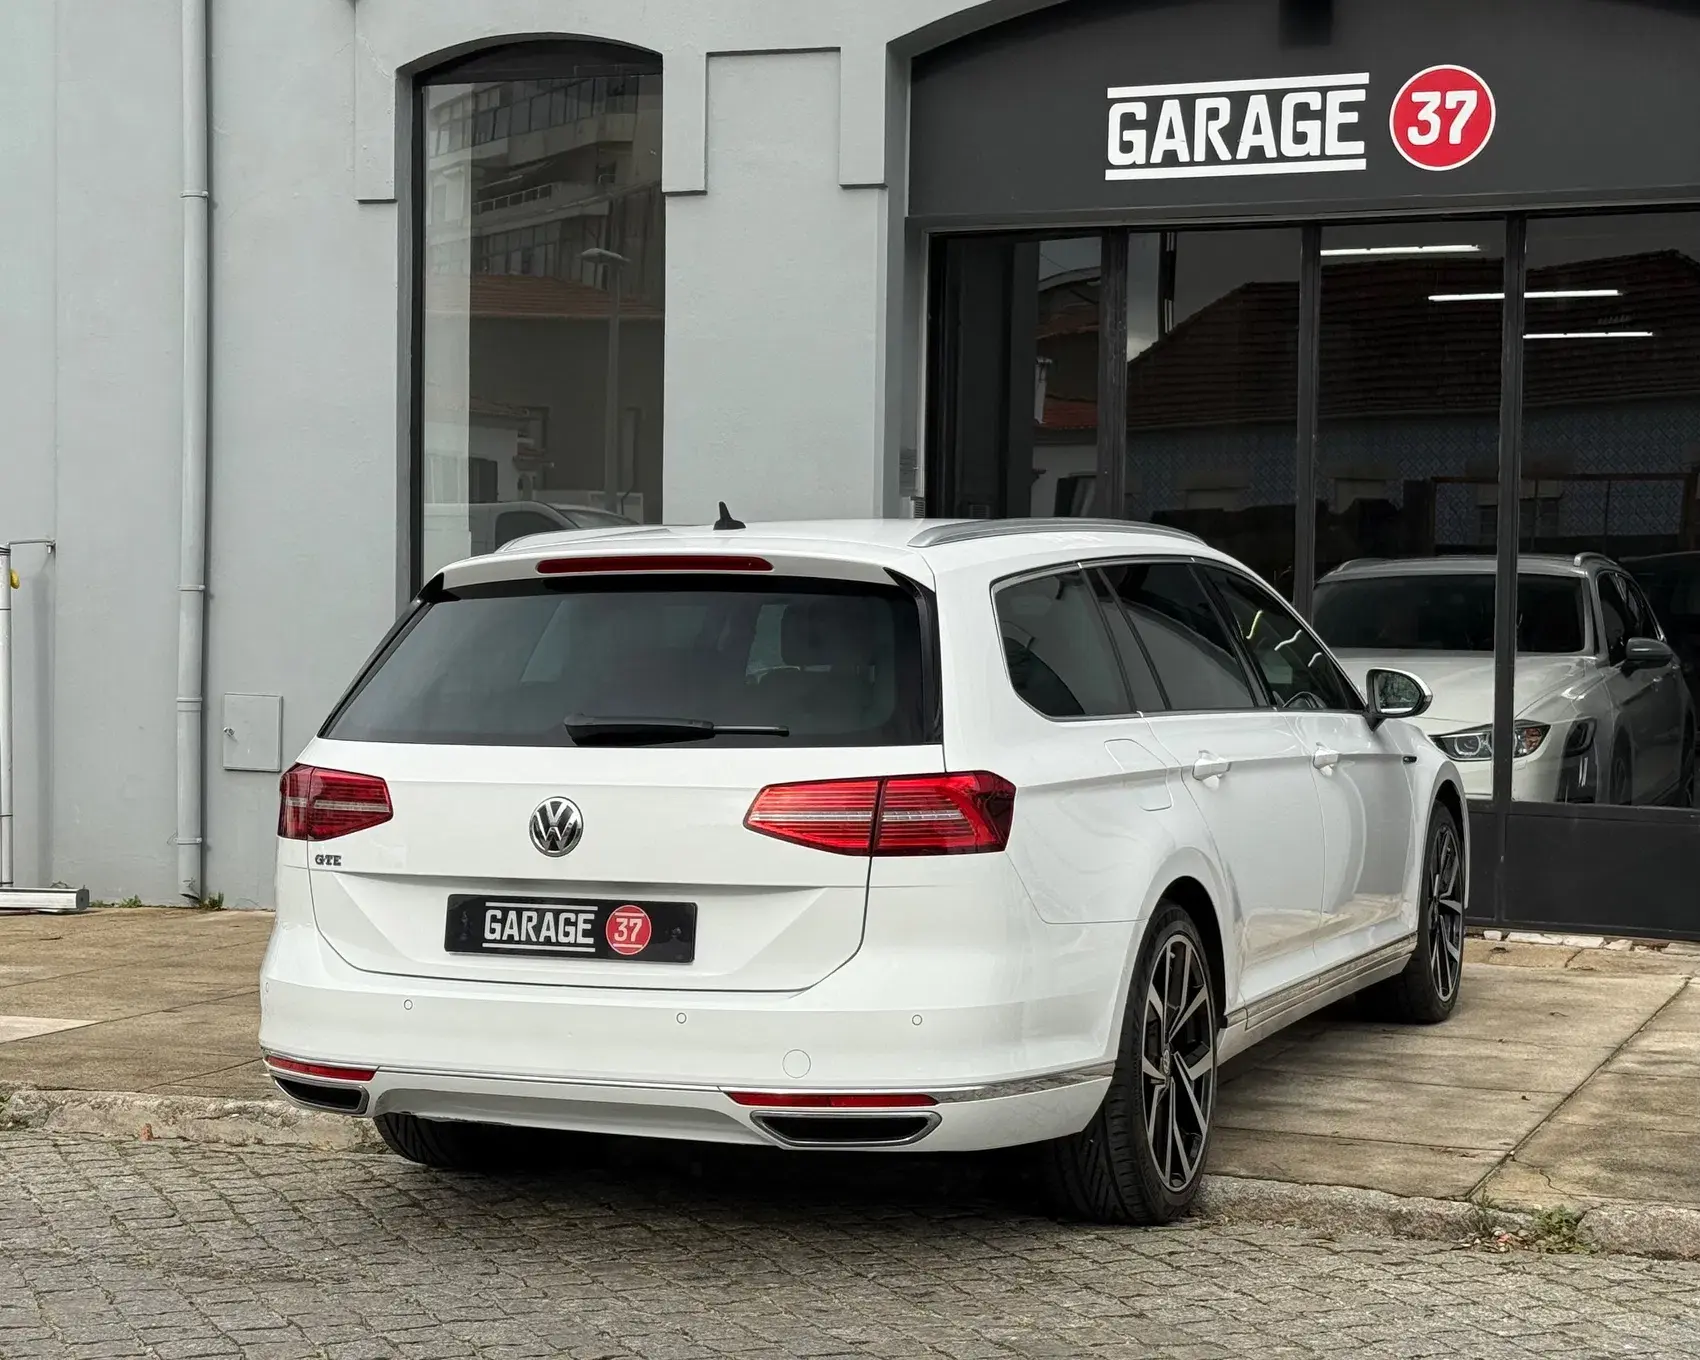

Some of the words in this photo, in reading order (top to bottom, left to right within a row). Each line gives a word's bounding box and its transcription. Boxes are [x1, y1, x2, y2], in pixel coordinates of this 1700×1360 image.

[1107, 89, 1366, 166] GARAGE
[1408, 90, 1478, 146] 37
[314, 853, 342, 867] GTE
[484, 909, 595, 944] GARAGE
[614, 917, 643, 942] 37
